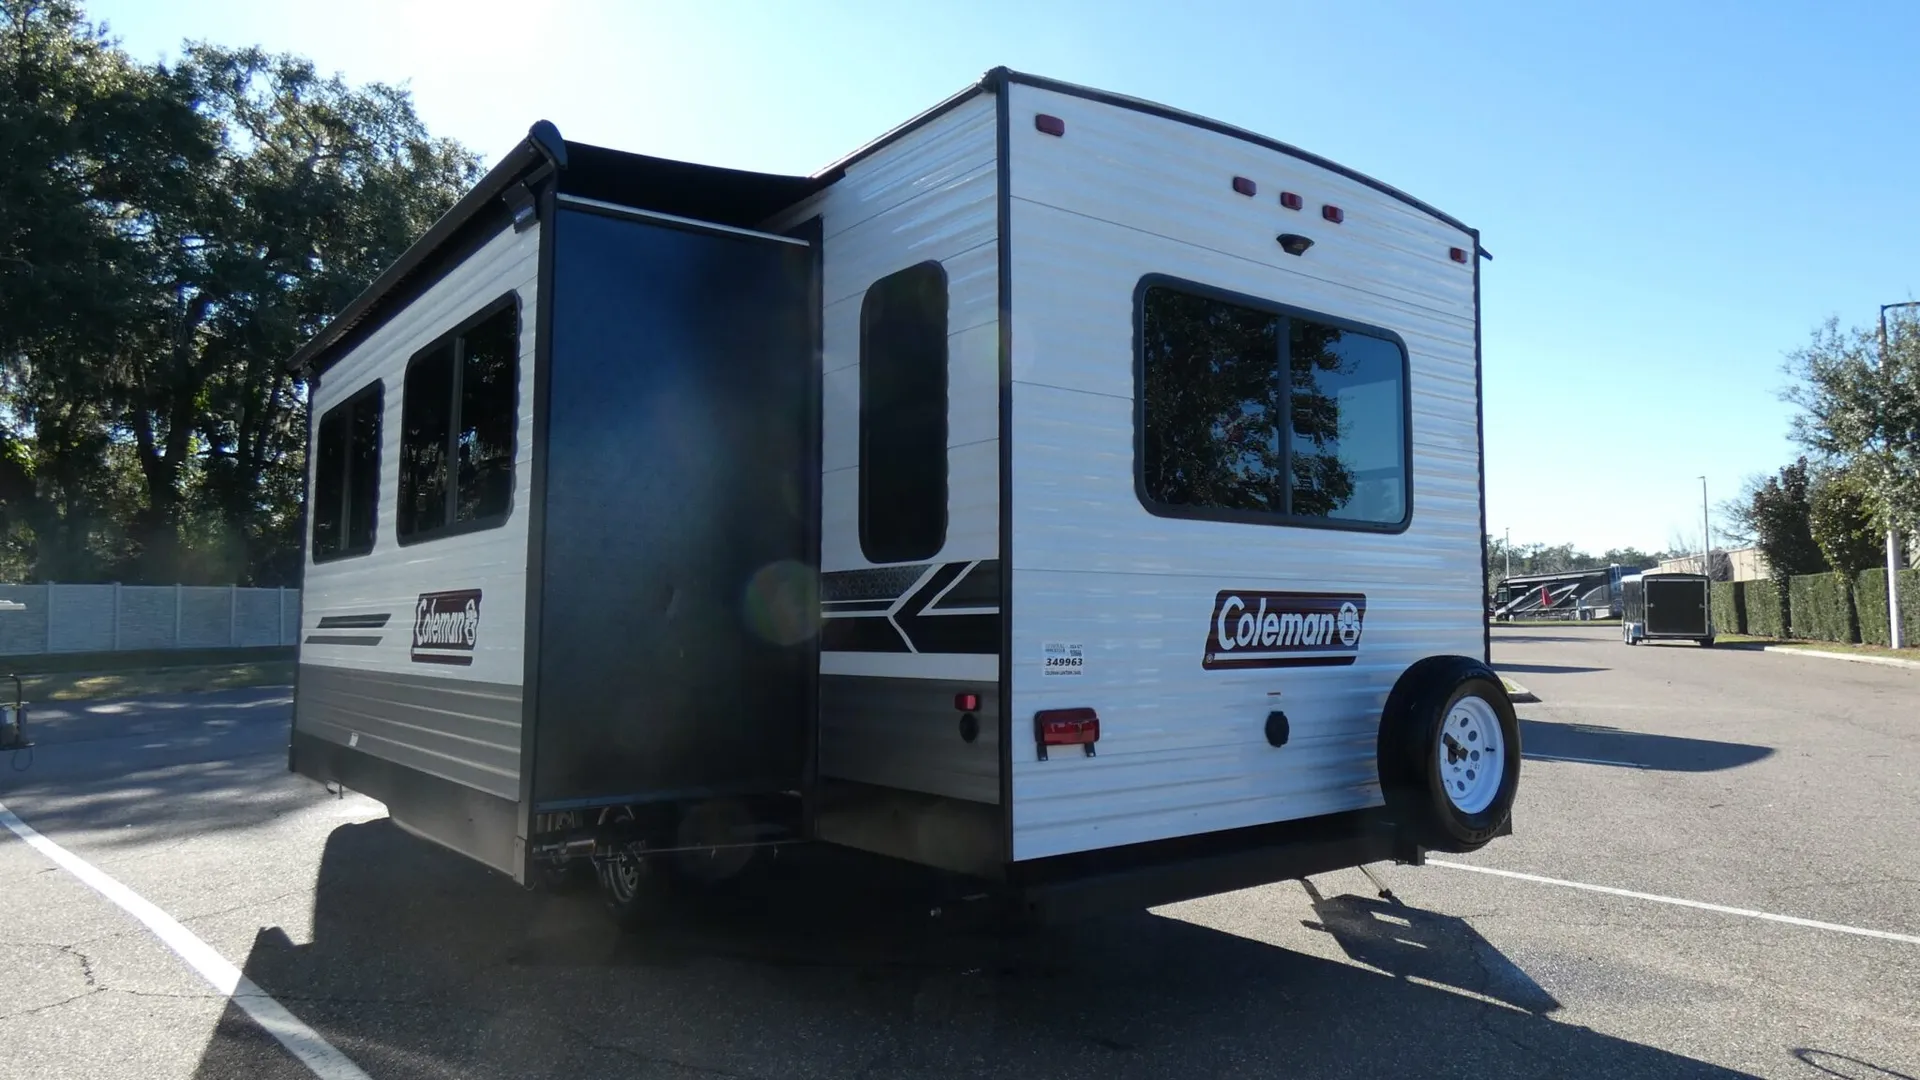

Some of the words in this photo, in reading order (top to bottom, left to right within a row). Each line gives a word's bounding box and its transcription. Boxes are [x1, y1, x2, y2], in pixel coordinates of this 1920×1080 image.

[416, 598, 465, 646] Coleman
[1218, 596, 1335, 650] Coleman
[1046, 658, 1083, 667] 349963
